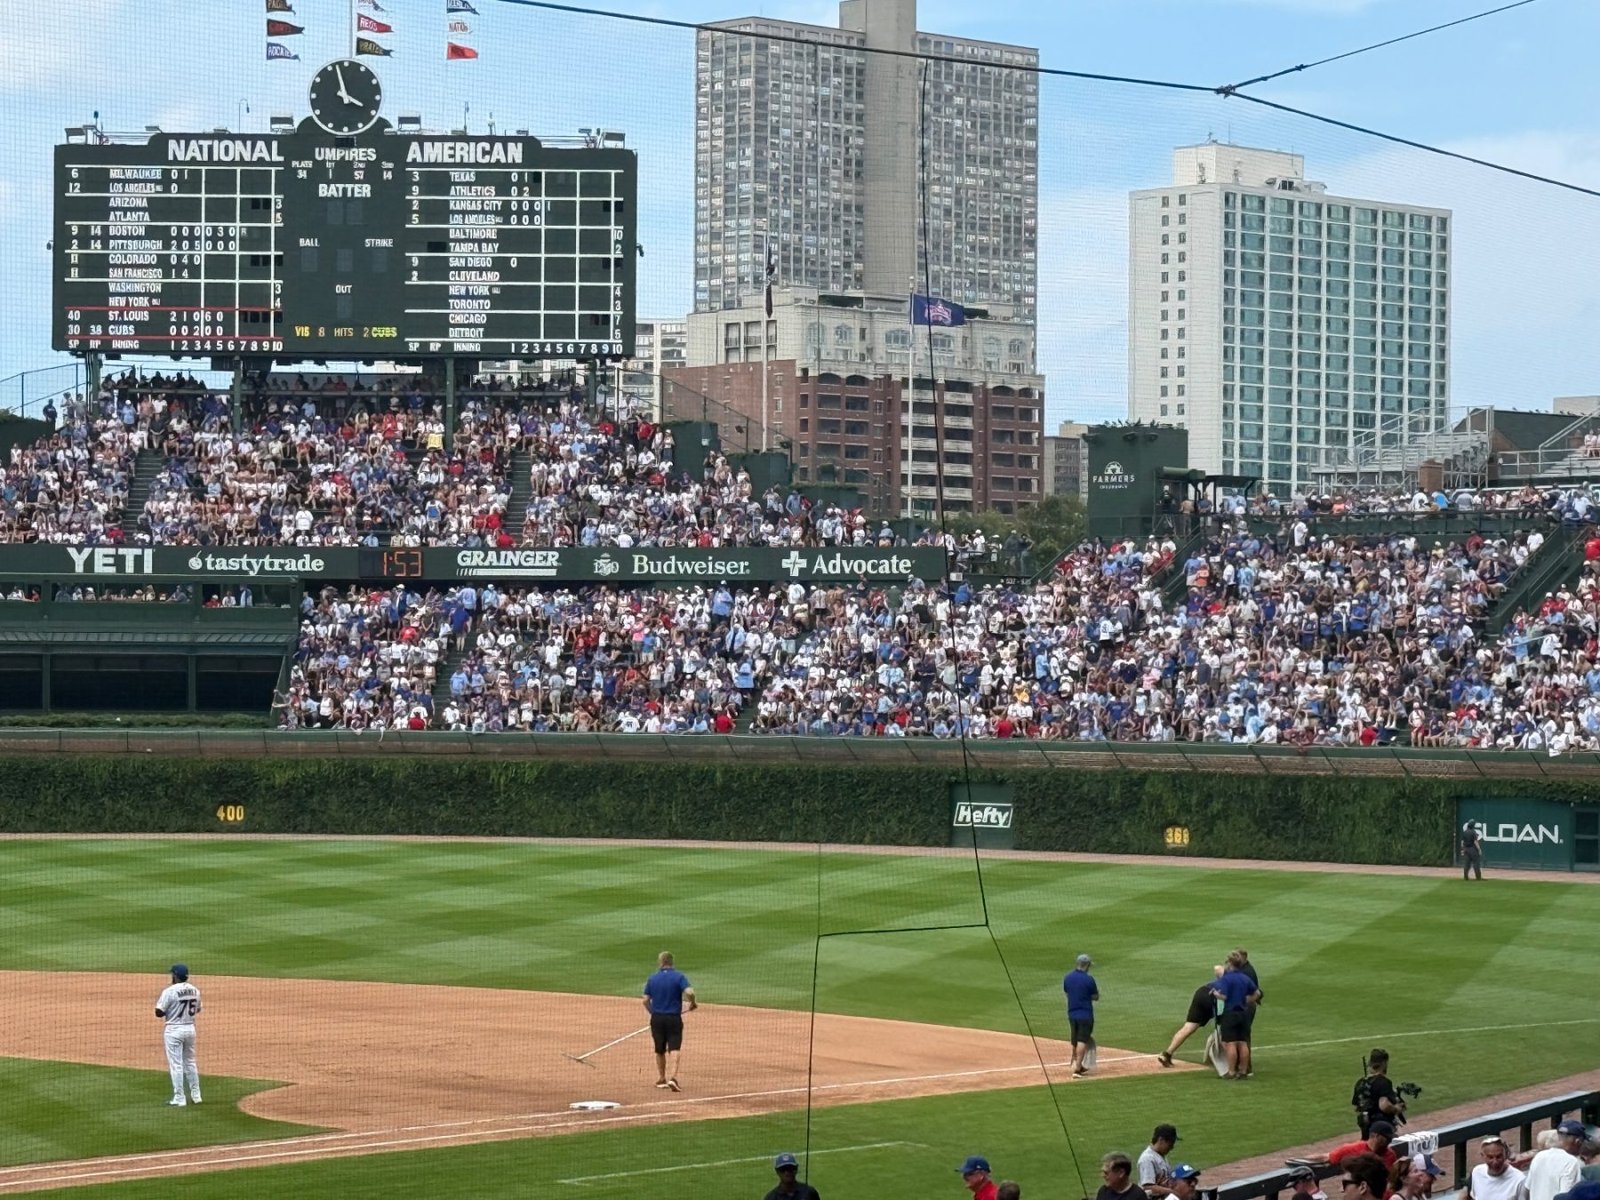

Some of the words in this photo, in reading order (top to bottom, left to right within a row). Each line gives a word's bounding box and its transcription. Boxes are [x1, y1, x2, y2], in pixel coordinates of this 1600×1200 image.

[168, 139, 284, 161] NATIONAL
[315, 148, 376, 161] UMPIRES
[406, 142, 522, 163] AMERICAN
[72, 169, 78, 178] 6
[110, 169, 162, 179] MILWAUKEE
[171, 169, 178, 179] 0
[412, 172, 419, 181] 3
[449, 172, 475, 182] TEXAS
[511, 172, 518, 182] 0
[69, 183, 80, 193] 12
[110, 183, 123, 193] LOS
[171, 183, 178, 193] 0
[319, 184, 371, 197] BATTER
[412, 186, 419, 196] 9
[450, 186, 495, 196] ATHLETICS
[511, 186, 517, 196] 0
[523, 186, 529, 196] 2
[109, 198, 148, 207] ARIZONA
[412, 201, 419, 210] 2
[450, 201, 482, 210] KANSAS
[484, 201, 502, 211] CITY
[511, 201, 517, 211] 0
[522, 201, 529, 211] 0
[534, 201, 541, 211] 0
[108, 212, 150, 222] ATLANTA
[412, 214, 419, 224] 5
[449, 214, 463, 224] LOS
[511, 215, 517, 225] 0
[522, 215, 529, 225] 0
[534, 215, 540, 225] 0
[72, 226, 78, 235] 9
[91, 226, 101, 236] 14
[109, 226, 145, 236] BOSTON
[171, 226, 177, 236] 0
[182, 226, 189, 236] 0
[194, 226, 201, 236] 0
[206, 227, 212, 236] 0
[217, 226, 224, 237] 3
[229, 226, 236, 236] 0
[449, 229, 498, 239] BALTIMORE
[71, 239, 78, 250] 2
[91, 240, 101, 250] 14
[109, 240, 162, 250] PITTSBURGH
[171, 240, 178, 250] 2
[182, 240, 189, 250] 0
[195, 240, 200, 250] 5
[206, 241, 212, 250] 0
[217, 241, 224, 250] 0
[229, 241, 236, 250] 0
[299, 238, 319, 246] BALL
[365, 239, 393, 247] STRIKE
[449, 243, 479, 253] TAMPA
[482, 243, 499, 253] BAY
[615, 244, 622, 254] 2
[109, 254, 157, 264] COLORADO
[171, 254, 177, 265] 0
[182, 254, 188, 265] 4
[194, 254, 200, 265] 0
[449, 257, 465, 267] SAN
[468, 257, 492, 267] DIEGO
[510, 257, 517, 268] 0
[109, 268, 123, 278] SAN
[123, 268, 162, 278] FRANCISCO
[182, 269, 188, 278] 4
[449, 271, 500, 282] CLEVELAND
[108, 282, 161, 293] WASHINGTON
[275, 284, 281, 294] 3
[336, 285, 352, 293] OUT
[449, 286, 466, 295] NEW
[468, 286, 489, 295] YORK
[109, 297, 126, 307] NEW
[128, 297, 149, 307] YORK
[275, 298, 281, 308] 4
[449, 300, 490, 310] TORONTO
[68, 310, 80, 320] 40
[124, 311, 149, 321] LOUIS
[170, 311, 176, 321] 2
[193, 311, 200, 321] 0
[205, 311, 211, 322] 6
[217, 311, 223, 321] 0
[449, 314, 487, 324] CHICAGO
[108, 325, 135, 335] CUBS
[170, 325, 176, 336] 0
[181, 325, 188, 336] 0
[193, 325, 199, 336] 2
[205, 325, 211, 336] 0
[216, 326, 223, 336] 0
[294, 326, 310, 337] VIS
[318, 326, 326, 337] 8
[334, 328, 354, 337] HITS
[363, 327, 370, 338] 2
[371, 327, 398, 338] CUBS
[449, 328, 485, 338] DETROIT
[112, 340, 139, 349] INNING
[181, 340, 188, 350] 2
[194, 340, 201, 350] 3
[204, 340, 211, 350] 4
[216, 340, 223, 350] 5
[228, 340, 234, 350] 6
[240, 341, 246, 351] 7
[251, 341, 258, 351] 8
[262, 341, 269, 351] 9
[273, 341, 283, 351] 10
[409, 342, 419, 351] SP
[430, 342, 441, 351] RP
[454, 342, 480, 351] INNING
[521, 343, 528, 353] 2
[533, 343, 540, 353] 3
[545, 343, 551, 353] 4
[556, 343, 563, 353] 5
[567, 344, 574, 353] 6
[579, 344, 586, 354] 7
[591, 344, 598, 354] 8
[602, 344, 609, 354] 9
[613, 344, 622, 354] 10
[1092, 475, 1135, 483] FARMERS
[67, 547, 153, 574] YETI
[457, 550, 560, 566] GRAINGER
[205, 554, 324, 576] tastytrade
[384, 551, 422, 577] 1:53
[632, 554, 748, 575] Budweiser
[812, 553, 912, 575] Advocate
[216, 805, 244, 821] 400
[958, 805, 1009, 826] Hefty
[178, 998, 197, 1018] 76
